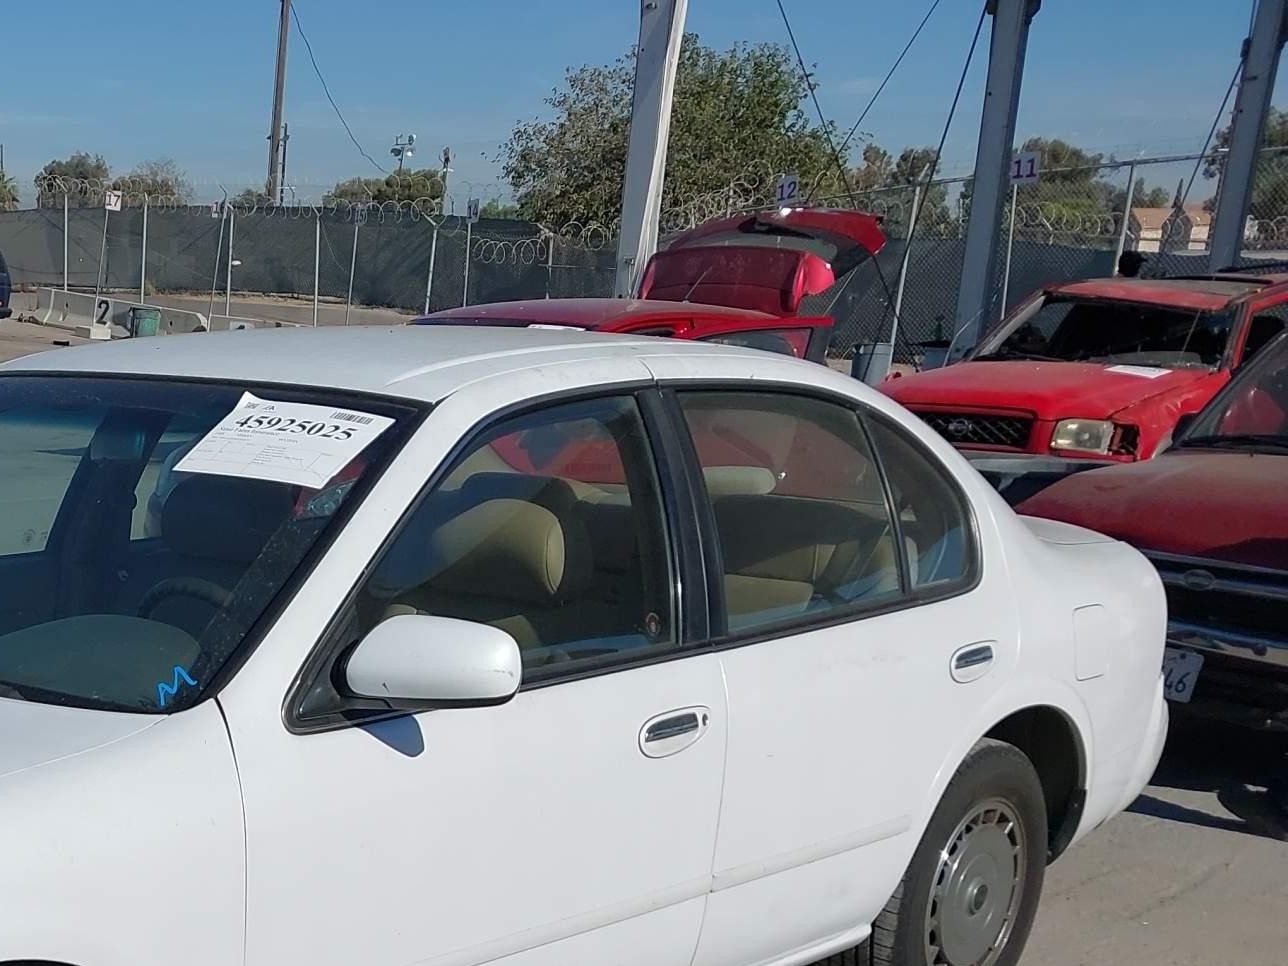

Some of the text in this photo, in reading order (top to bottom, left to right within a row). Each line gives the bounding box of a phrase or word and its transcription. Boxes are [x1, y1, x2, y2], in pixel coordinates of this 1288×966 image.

[1012, 158, 1037, 180] 11
[106, 194, 120, 207] 17
[777, 181, 797, 202] 12
[96, 299, 110, 325] 2
[236, 414, 359, 441] 45925025
